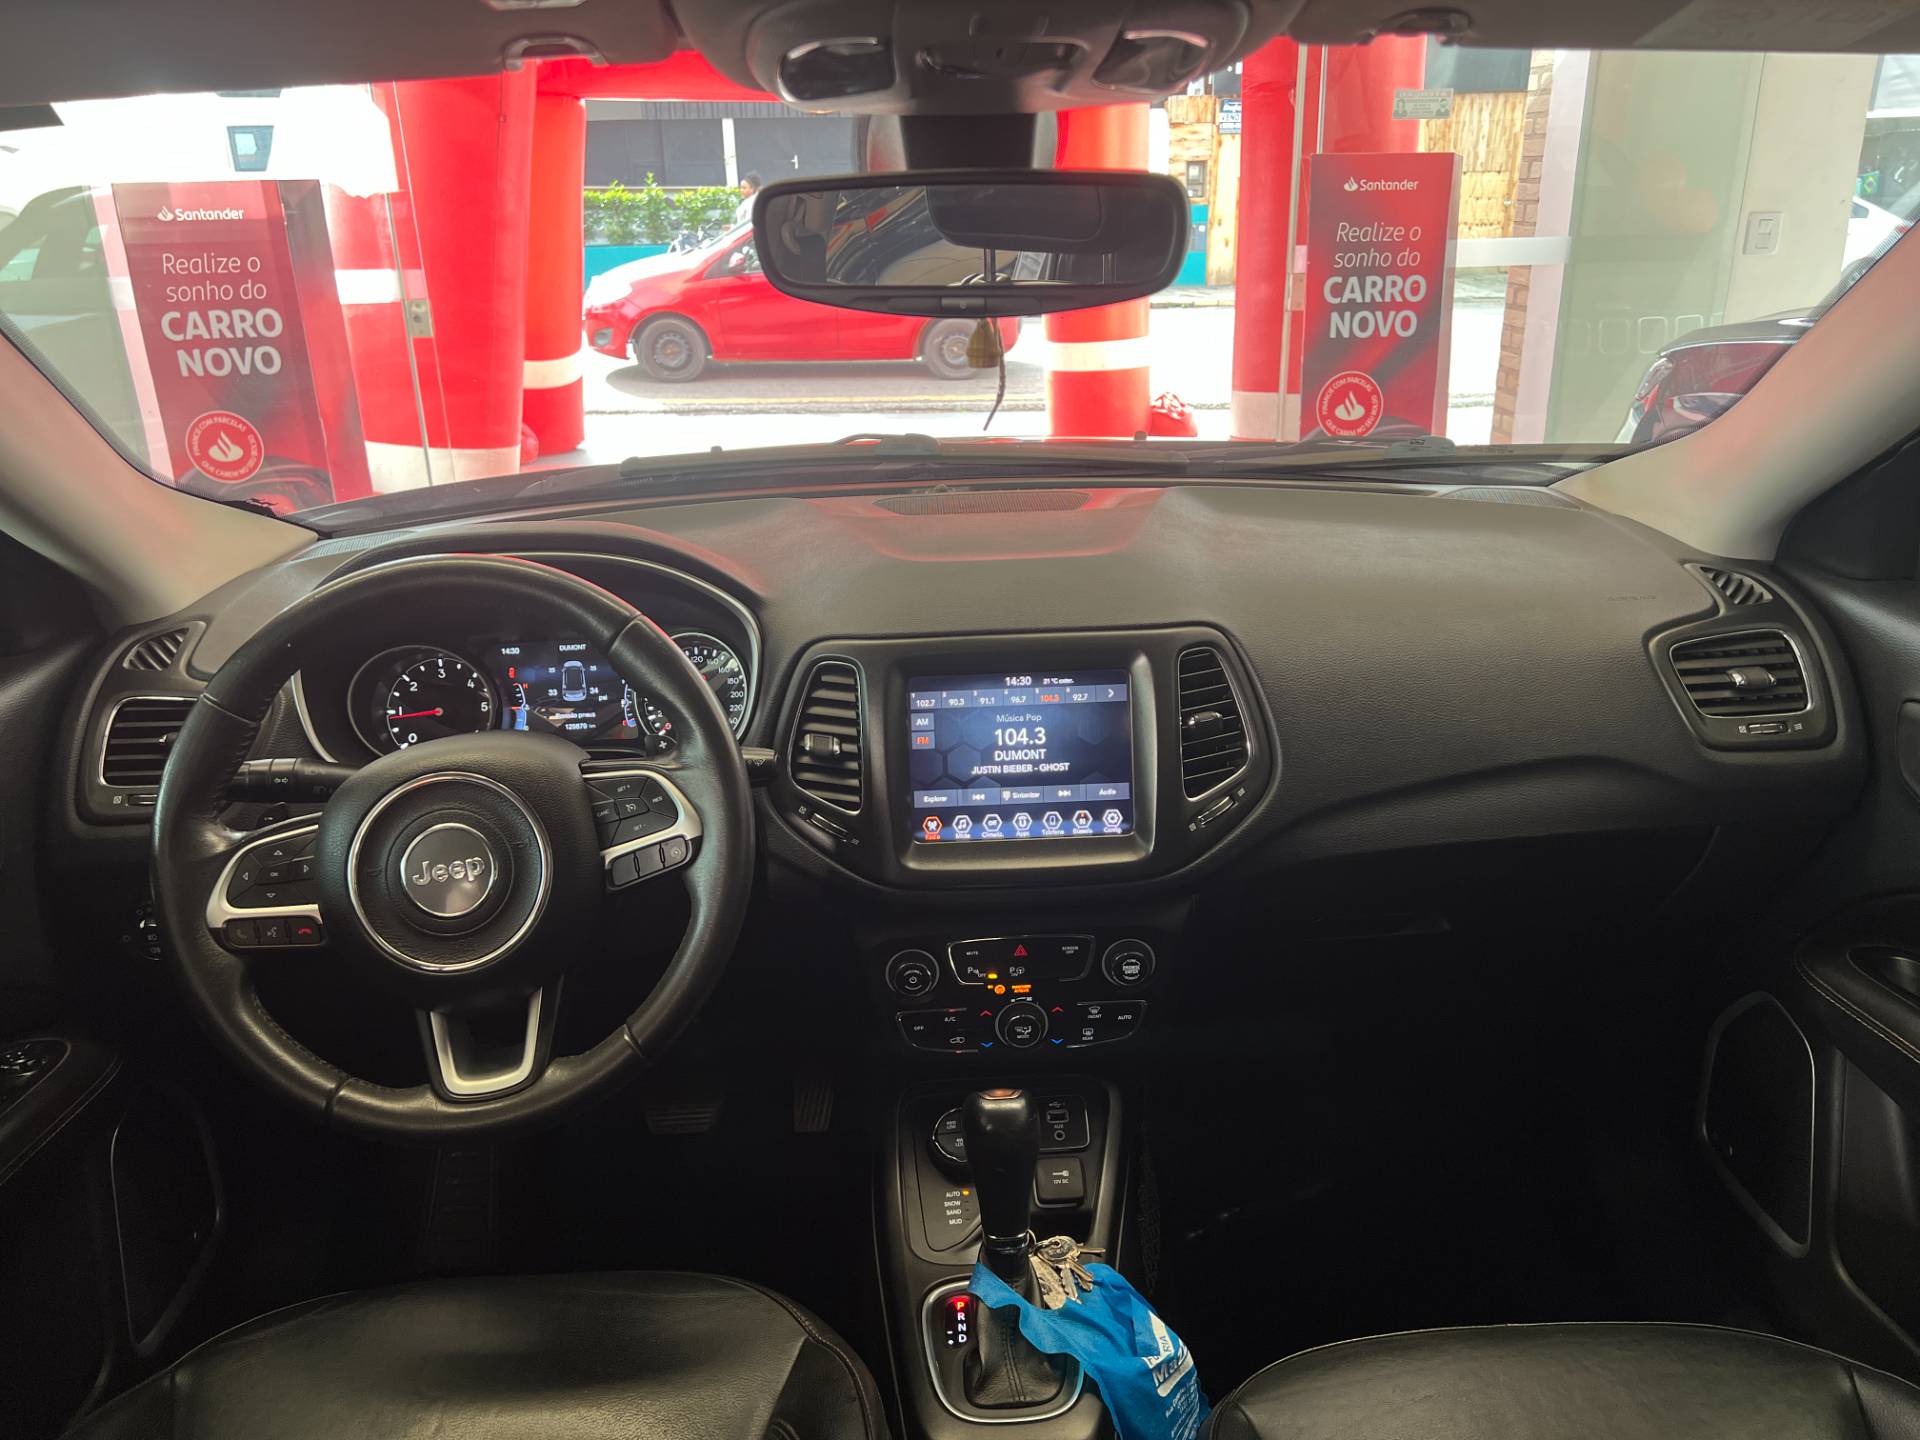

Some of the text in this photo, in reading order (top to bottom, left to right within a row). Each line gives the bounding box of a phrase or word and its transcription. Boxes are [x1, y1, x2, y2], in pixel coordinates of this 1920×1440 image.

[1360, 178, 1419, 192] Santander
[175, 208, 244, 222] Santander
[1336, 222, 1422, 242] Realize o
[162, 252, 260, 275] Realize o
[1334, 248, 1420, 268] sonho do
[166, 279, 267, 303] sonho do
[1323, 274, 1427, 304] CARRO
[160, 308, 284, 342] CARRO
[1329, 310, 1418, 338] NOVO
[176, 345, 282, 377] NOVO
[560, 644, 586, 652] DUMONT
[438, 668, 446, 678] 3
[409, 682, 418, 692] 2
[467, 679, 475, 688] 4
[1005, 676, 1032, 686] 14:30
[916, 699, 936, 708] 102.7
[1072, 693, 1088, 701] 92.7
[480, 702, 488, 712] 5
[1026, 713, 1042, 722] Pop
[408, 733, 418, 743] 0
[917, 736, 929, 744] FM
[994, 727, 1046, 746] 104.3
[994, 749, 1047, 761] DUMONT
[971, 765, 1001, 775] JUSTIN
[1003, 764, 1033, 773] BIEBER
[1039, 762, 1070, 772] GHOST
[412, 857, 485, 886] Jeep
[957, 1302, 965, 1310] P
[958, 1312, 966, 1320] R
[958, 1323, 967, 1332] N
[958, 1334, 967, 1343] D
